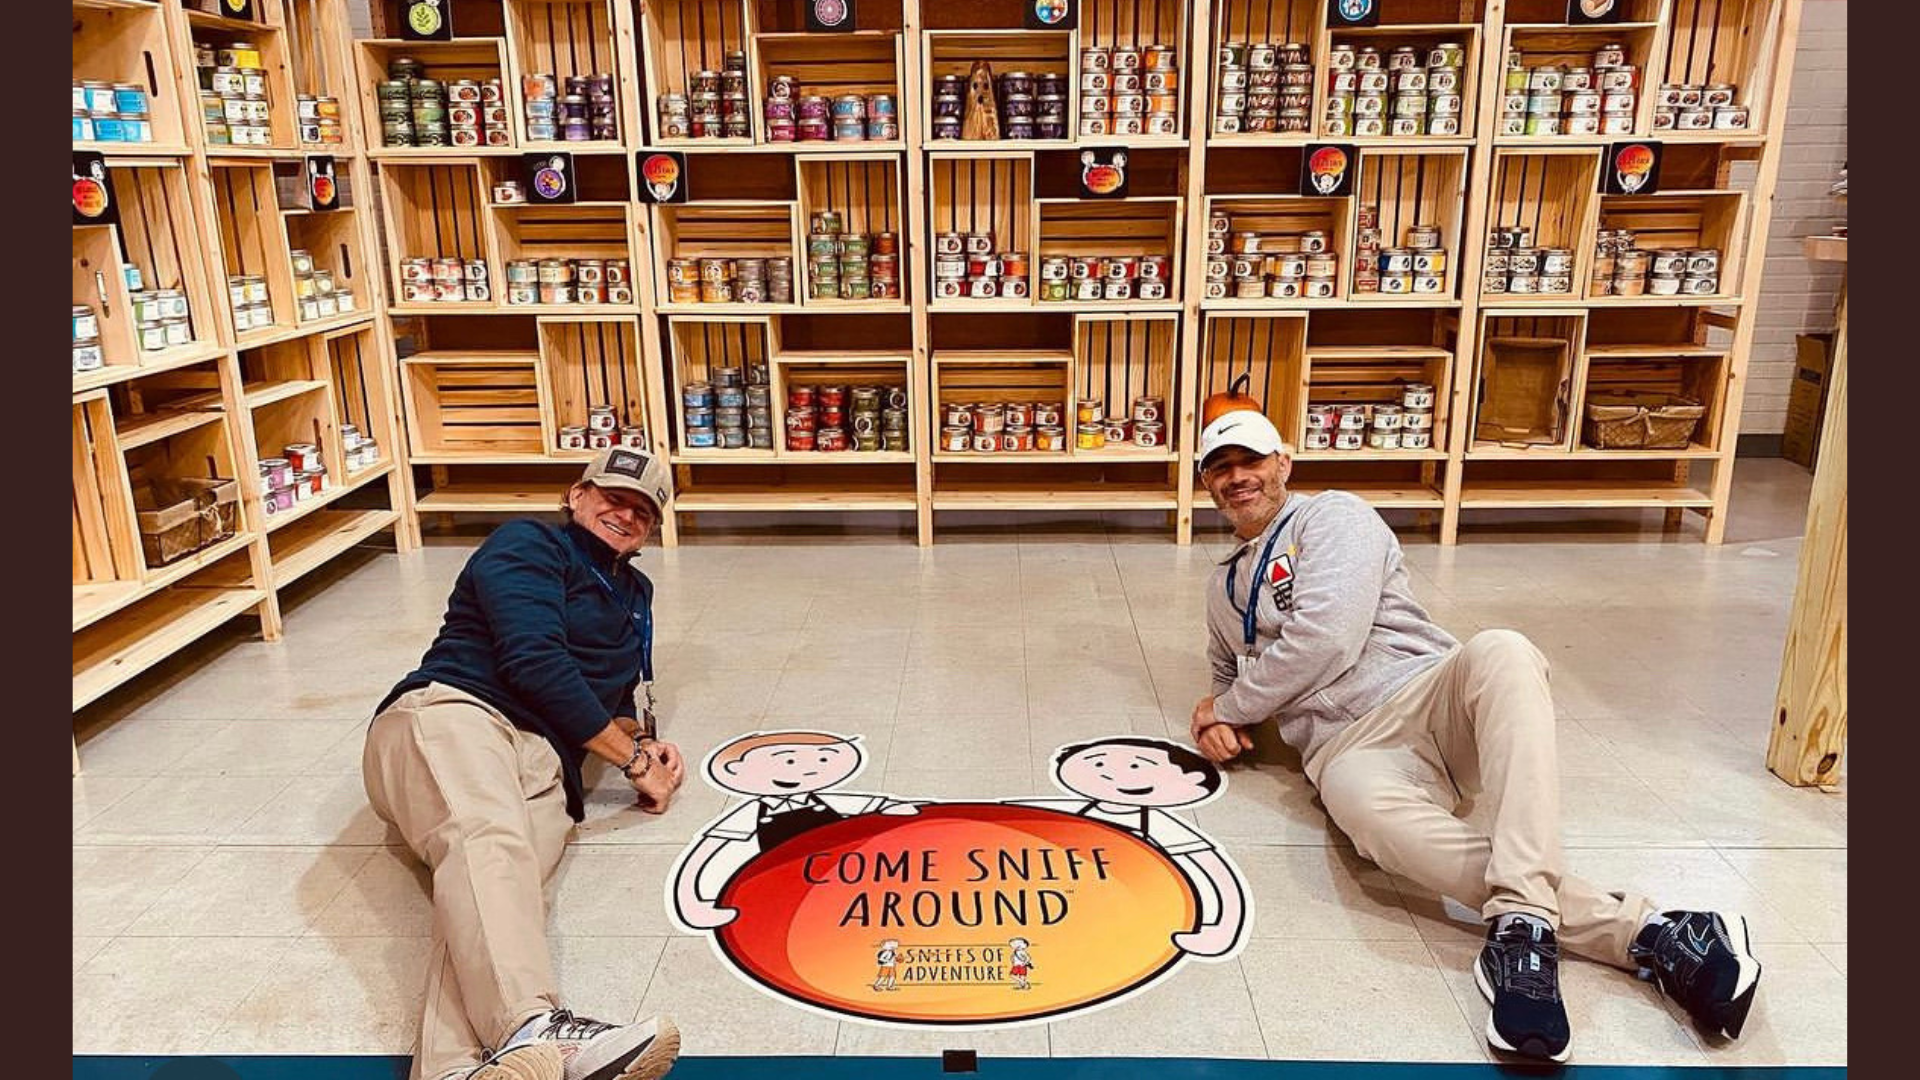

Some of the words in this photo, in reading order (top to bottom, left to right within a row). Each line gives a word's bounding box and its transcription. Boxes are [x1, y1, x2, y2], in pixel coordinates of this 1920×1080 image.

[803, 850, 940, 884] COME
[966, 848, 1110, 882] SNIFF
[839, 889, 1069, 927] AROUND
[905, 948, 975, 964] SNIFFS
[982, 947, 1004, 963] OF
[903, 966, 1005, 981] ADVENTURE
